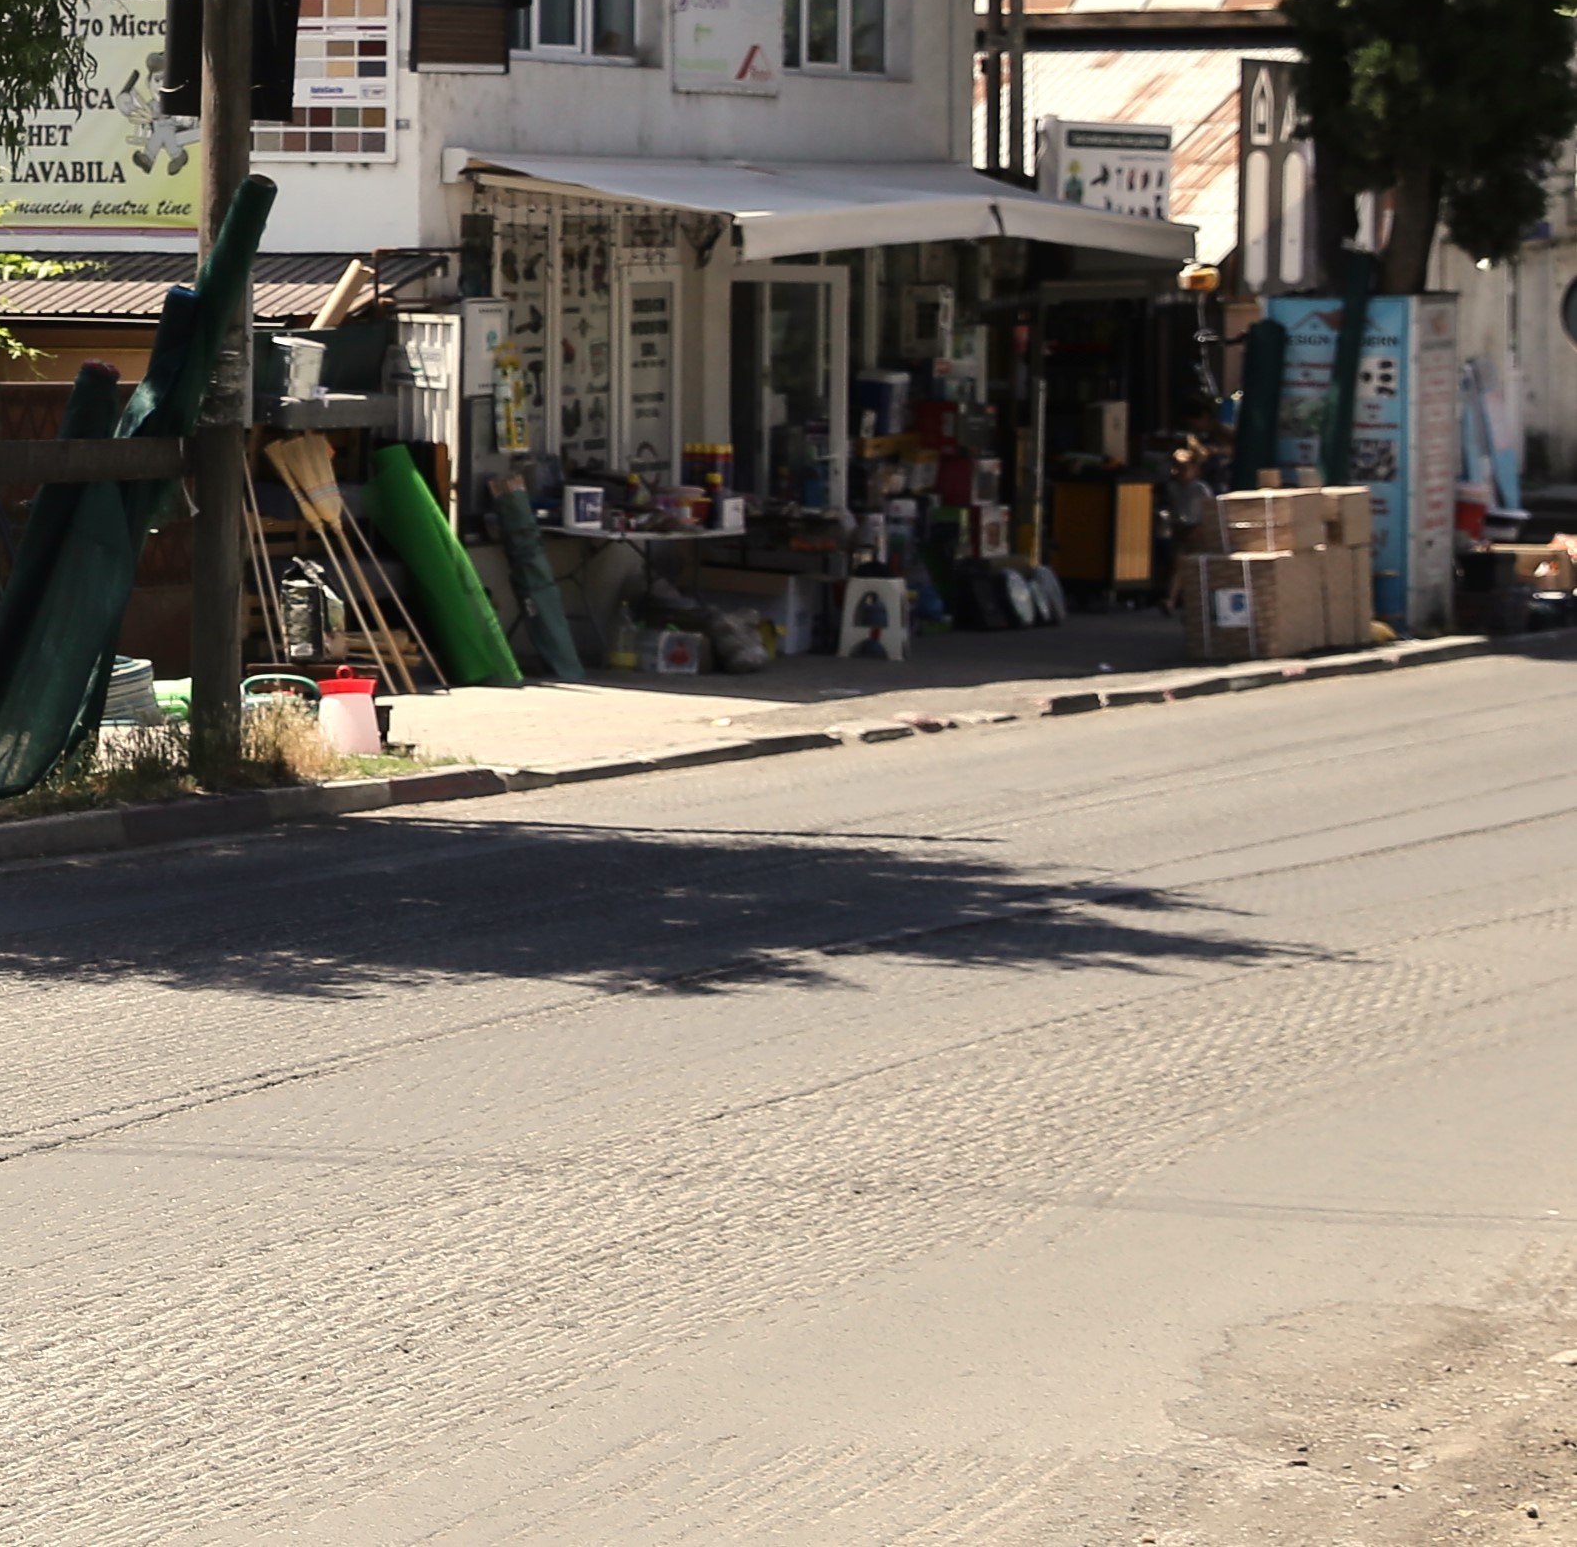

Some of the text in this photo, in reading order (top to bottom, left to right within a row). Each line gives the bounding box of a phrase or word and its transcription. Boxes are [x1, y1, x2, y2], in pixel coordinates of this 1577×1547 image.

[10, 161, 126, 183] LAVABILA
[14, 200, 83, 215] muncim
[89, 199, 149, 219] pentru
[156, 199, 192, 215] tine
